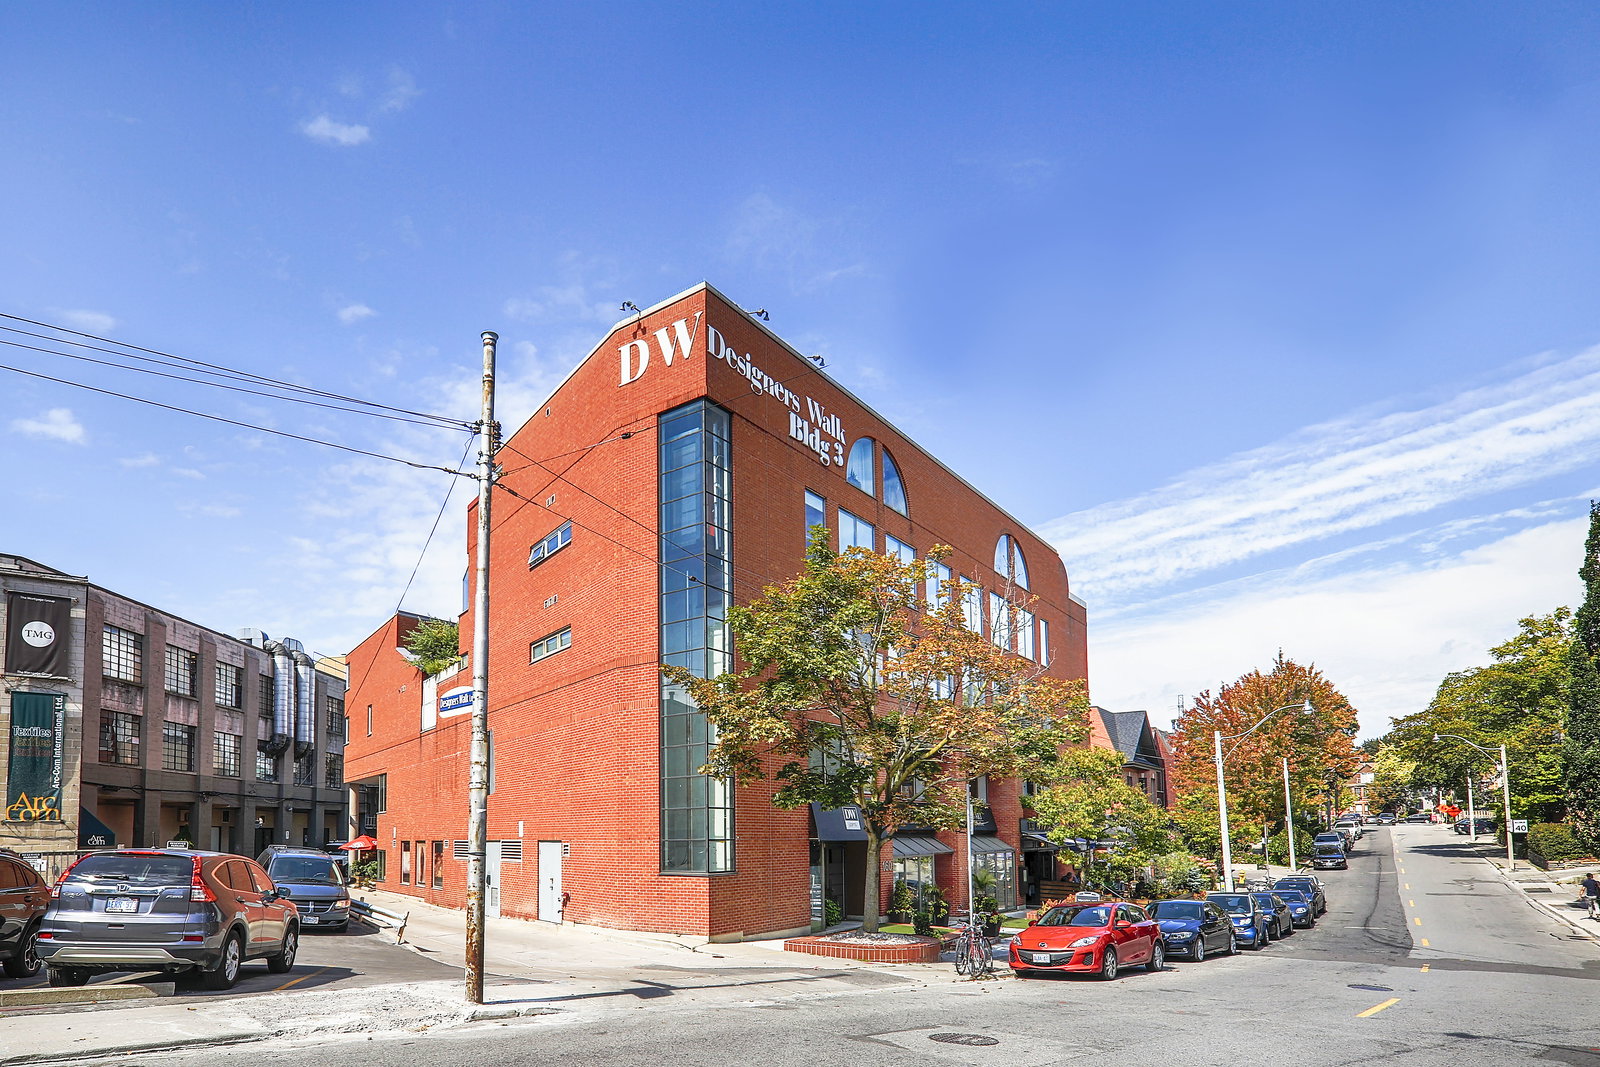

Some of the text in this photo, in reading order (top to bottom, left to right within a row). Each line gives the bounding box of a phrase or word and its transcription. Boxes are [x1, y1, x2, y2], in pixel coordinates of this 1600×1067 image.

[707, 324, 846, 445] Designers Walk
[788, 411, 844, 466] Bldg 3
[25, 629, 53, 639] TMG
[12, 725, 51, 737] Textiles
[13, 791, 57, 812] Arc
[6, 804, 60, 820] Com
